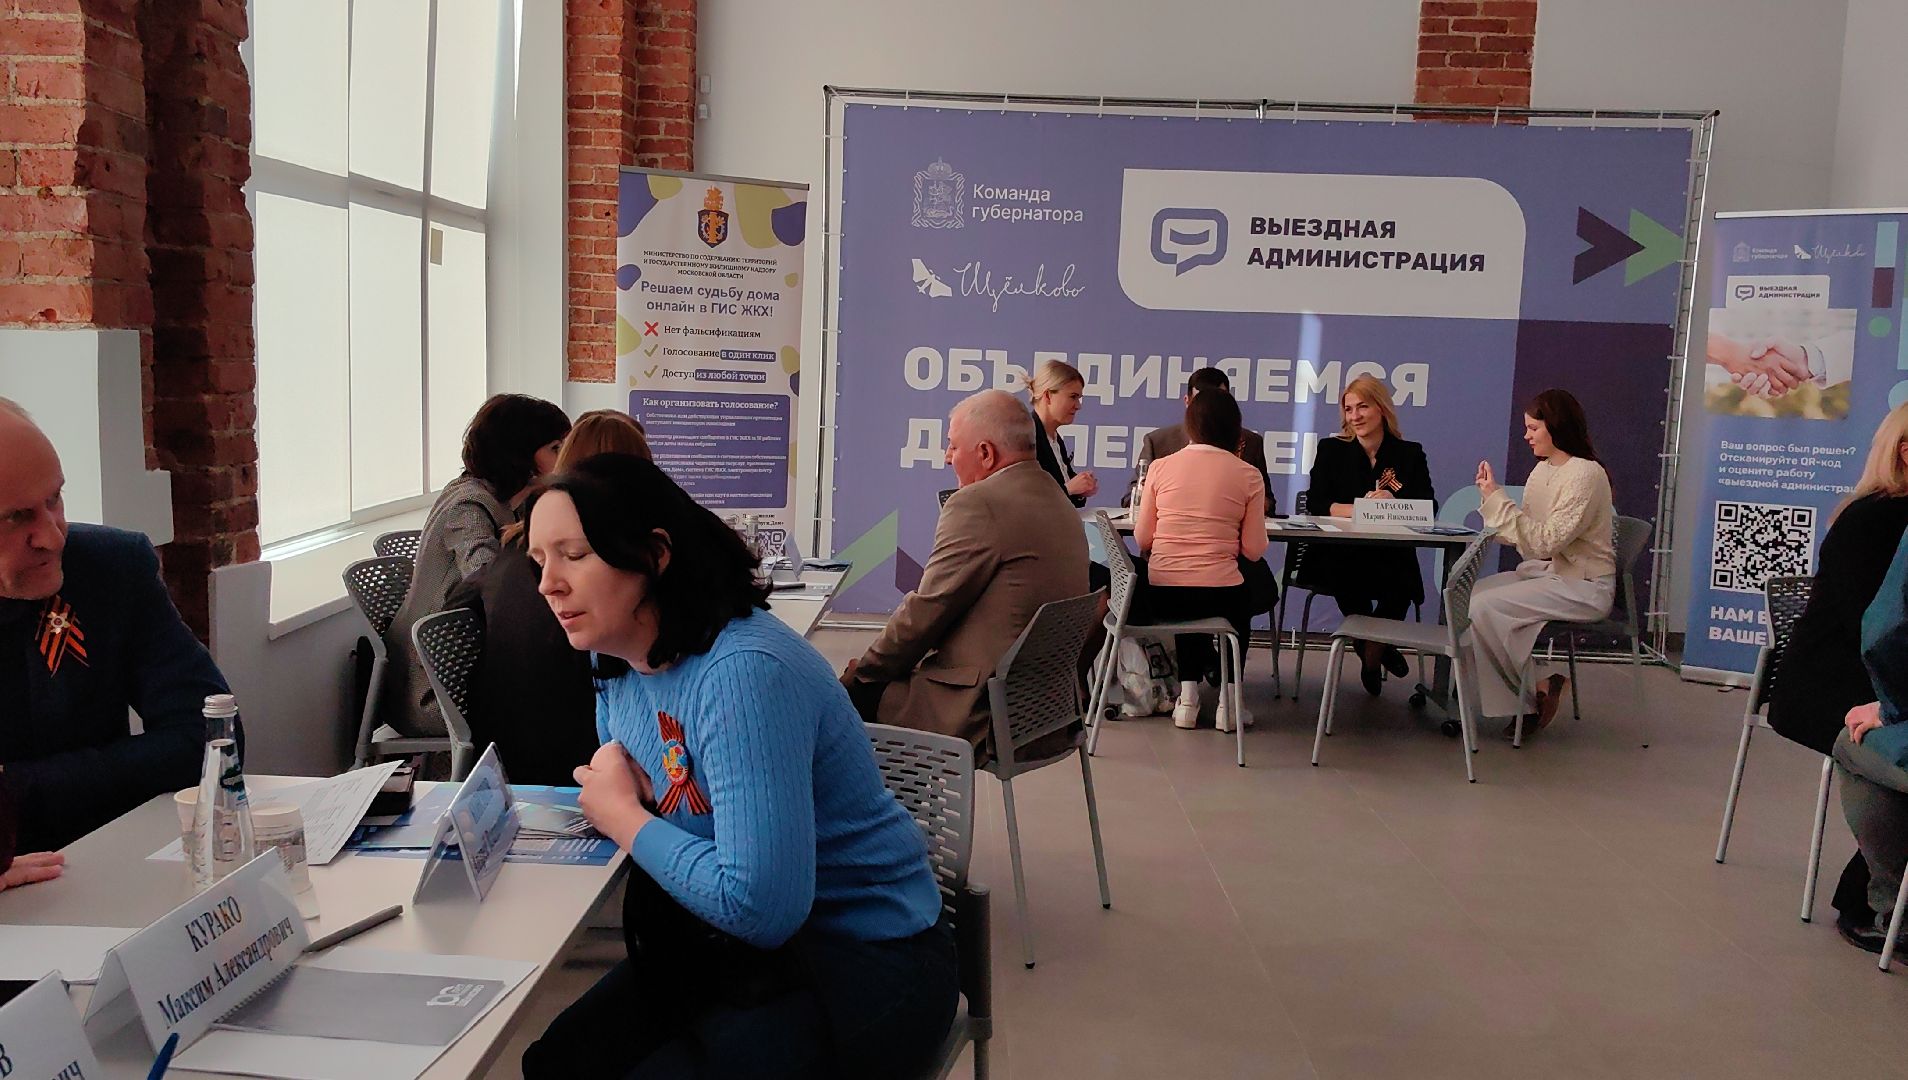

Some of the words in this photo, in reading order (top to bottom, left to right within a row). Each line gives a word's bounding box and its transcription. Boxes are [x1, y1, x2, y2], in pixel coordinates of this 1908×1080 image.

[973, 184, 1051, 204] Команда
[972, 204, 1084, 224] губернатора
[1250, 216, 1396, 241] ВЫЕЗДНАЯ
[643, 250, 690, 260] МИНИСТЕРСТВО
[699, 254, 740, 263] СОДЕРЖАНИЮ
[741, 257, 778, 266] ТЕРРИТОРИЙ
[649, 259, 708, 269] ГОСУДАРСТВЕННОМУ
[1247, 247, 1485, 274] АДМИНИСТРАЦИЯ
[677, 269, 717, 278] МОСКОВСКОЙ
[717, 272, 744, 280] ОБЛАСТИ
[641, 280, 693, 295] Решаем
[697, 286, 743, 301] судьбу
[746, 290, 780, 301] дома
[953, 261, 1086, 313] Щёлково
[646, 300, 695, 313] онлайн
[699, 304, 707, 313] в
[711, 302, 737, 315] ГИС
[741, 304, 774, 317] ЖКХ!
[664, 325, 681, 334] Нет
[682, 325, 761, 338] фальсификациям
[663, 347, 720, 358] Голосование
[728, 351, 751, 359] один
[752, 352, 775, 360] клик
[661, 368, 695, 380] Доступ
[707, 370, 738, 380] любой
[739, 373, 766, 381] точки
[642, 397, 659, 406] Как
[659, 399, 720, 409] организовать
[720, 401, 779, 410] голосование?
[1721, 440, 1744, 450] Ваш
[1745, 444, 1785, 455] вопрос
[1787, 444, 1810, 454] был
[1812, 446, 1857, 456] решен?
[1719, 452, 1798, 466] Отсканируйте
[1800, 457, 1842, 468] QR-код
[1718, 466, 1727, 474] и
[1728, 466, 1774, 479] оцените
[1775, 468, 1816, 479] работу
[1718, 477, 1779, 489] «выездной
[1375, 502, 1414, 511] ТАРАСОВА
[1710, 605, 1753, 623] НАМ
[1708, 626, 1767, 646] ВАШЕ
[184, 895, 243, 953] КУРАКО
[157, 975, 215, 1030] Максим
[212, 916, 295, 992] Александрович
